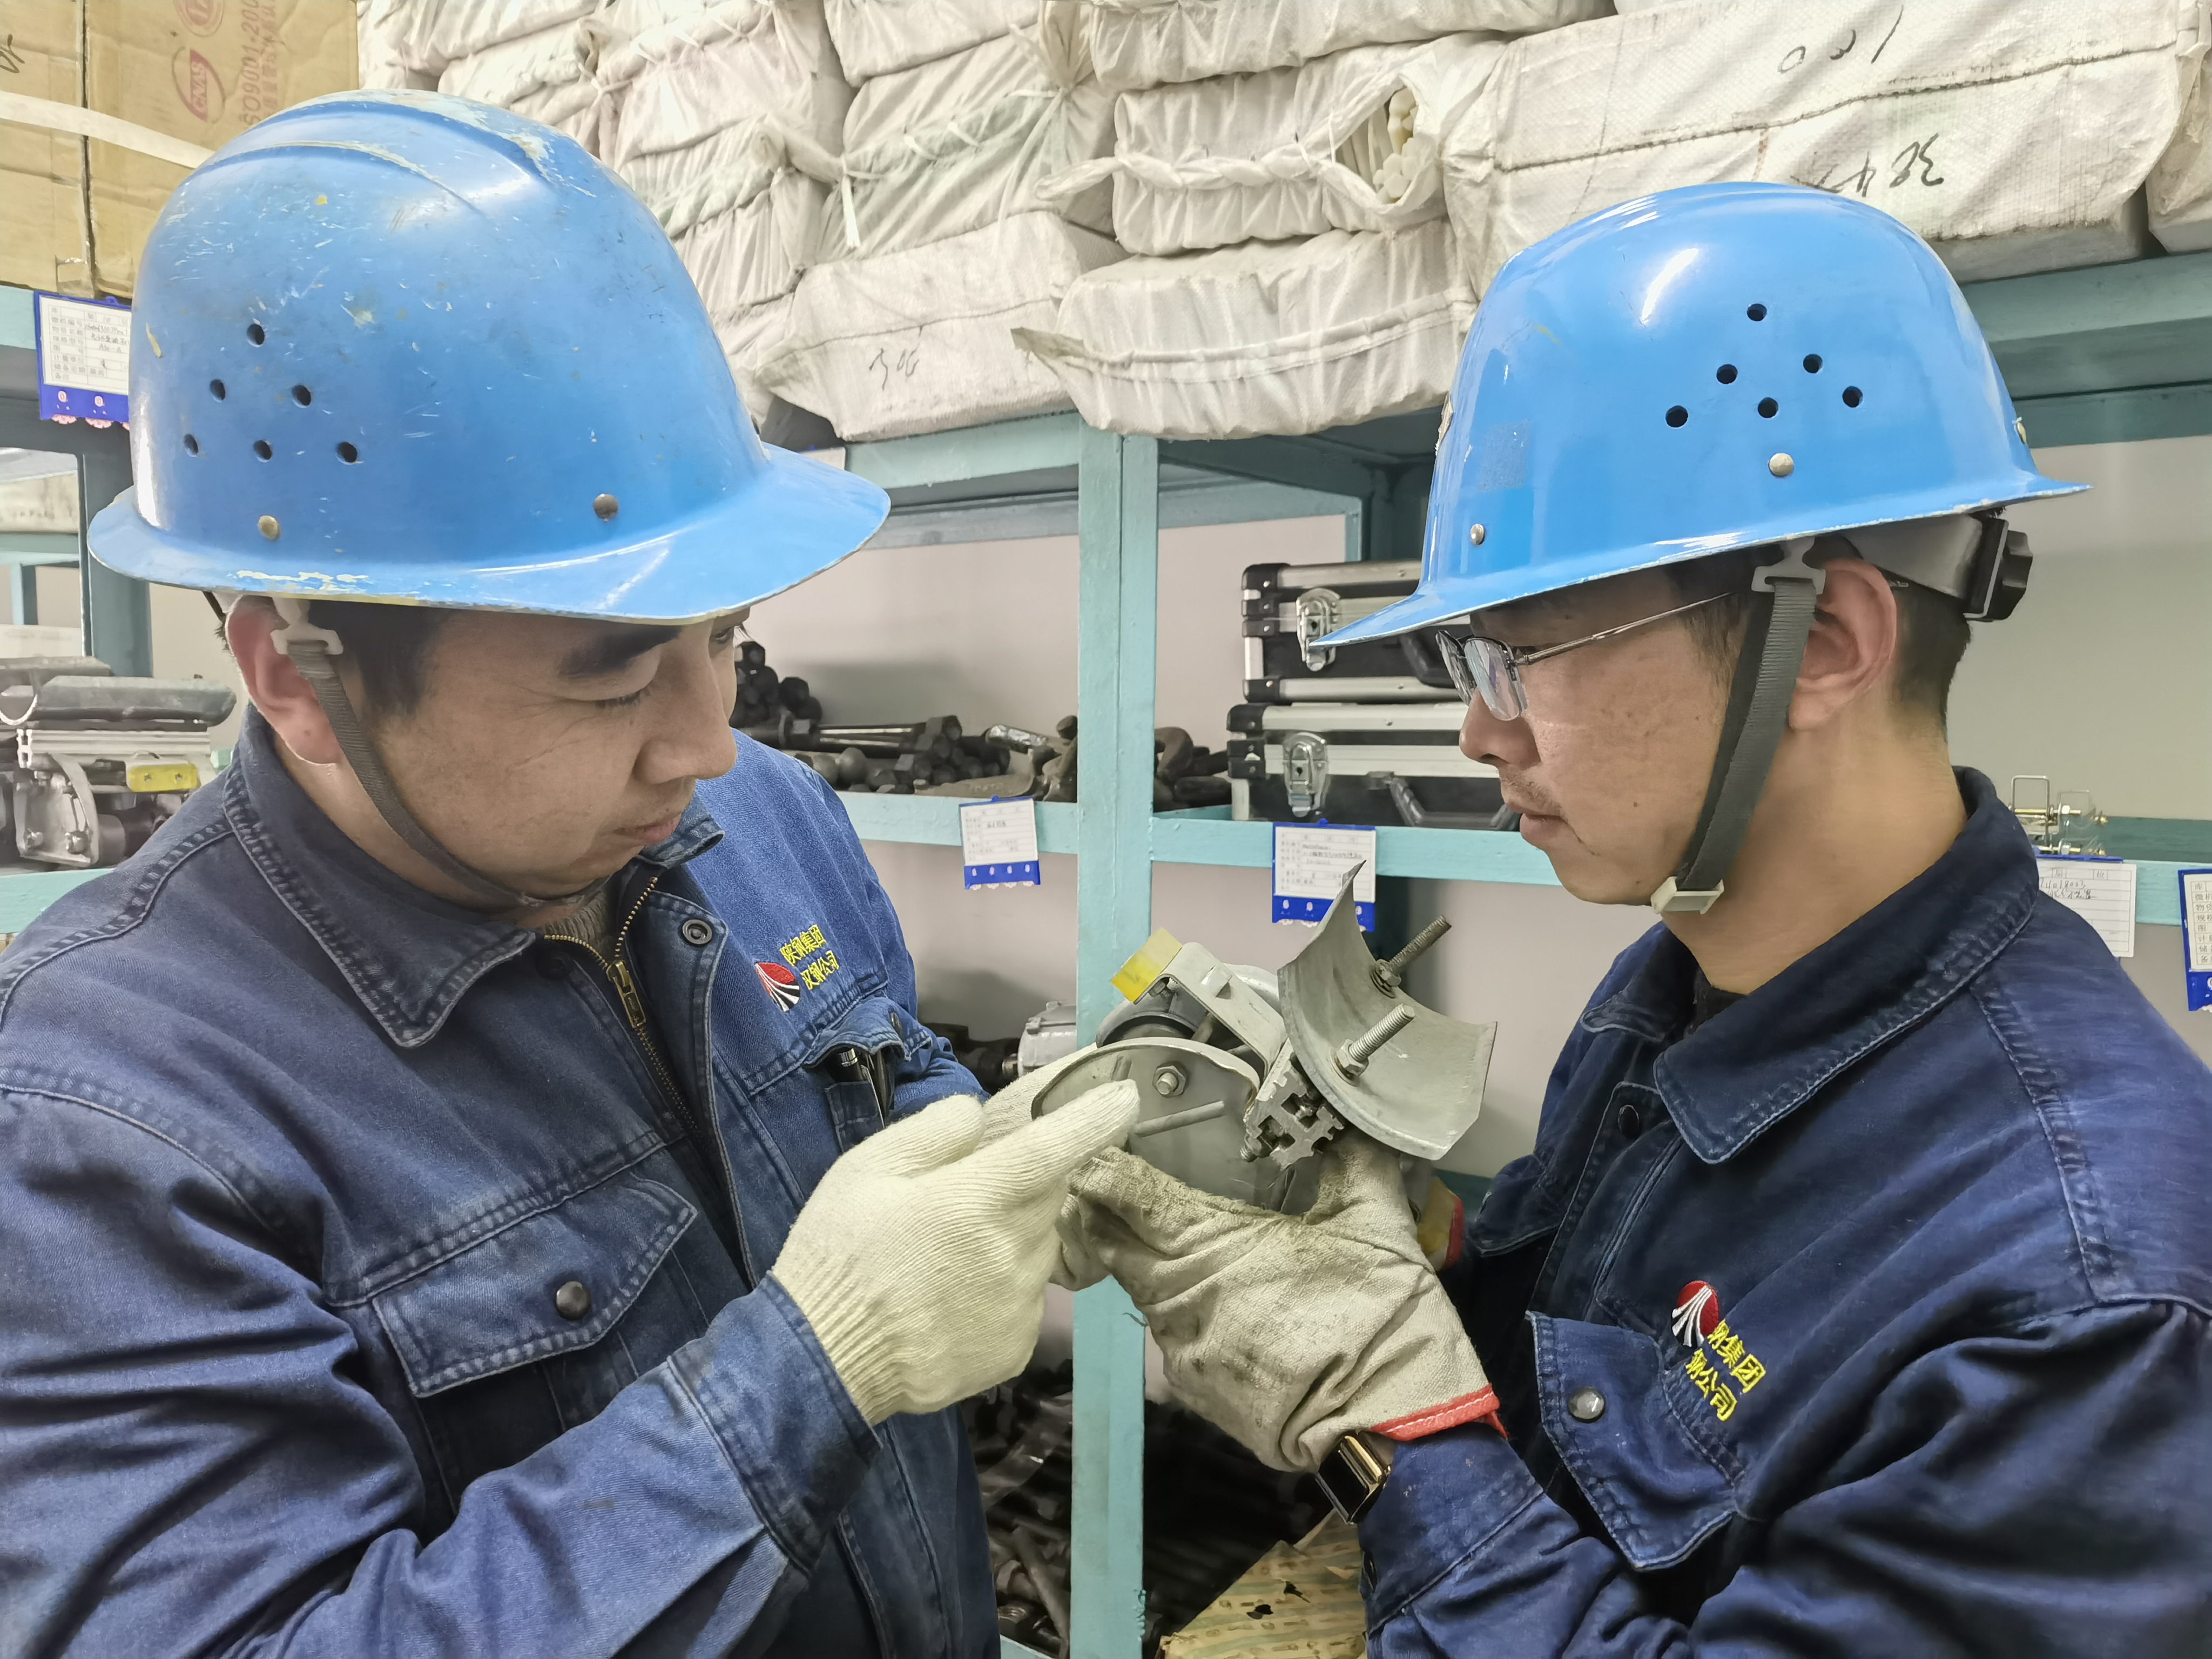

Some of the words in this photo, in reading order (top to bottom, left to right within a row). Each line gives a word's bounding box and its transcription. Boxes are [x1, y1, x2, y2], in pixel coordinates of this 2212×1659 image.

[1777, 5, 1904, 73] 100
[191, 62, 207, 113] CNAS
[1685, 1348, 1738, 1421] 钢公司
[1707, 1318, 1766, 1393] 钢集团
